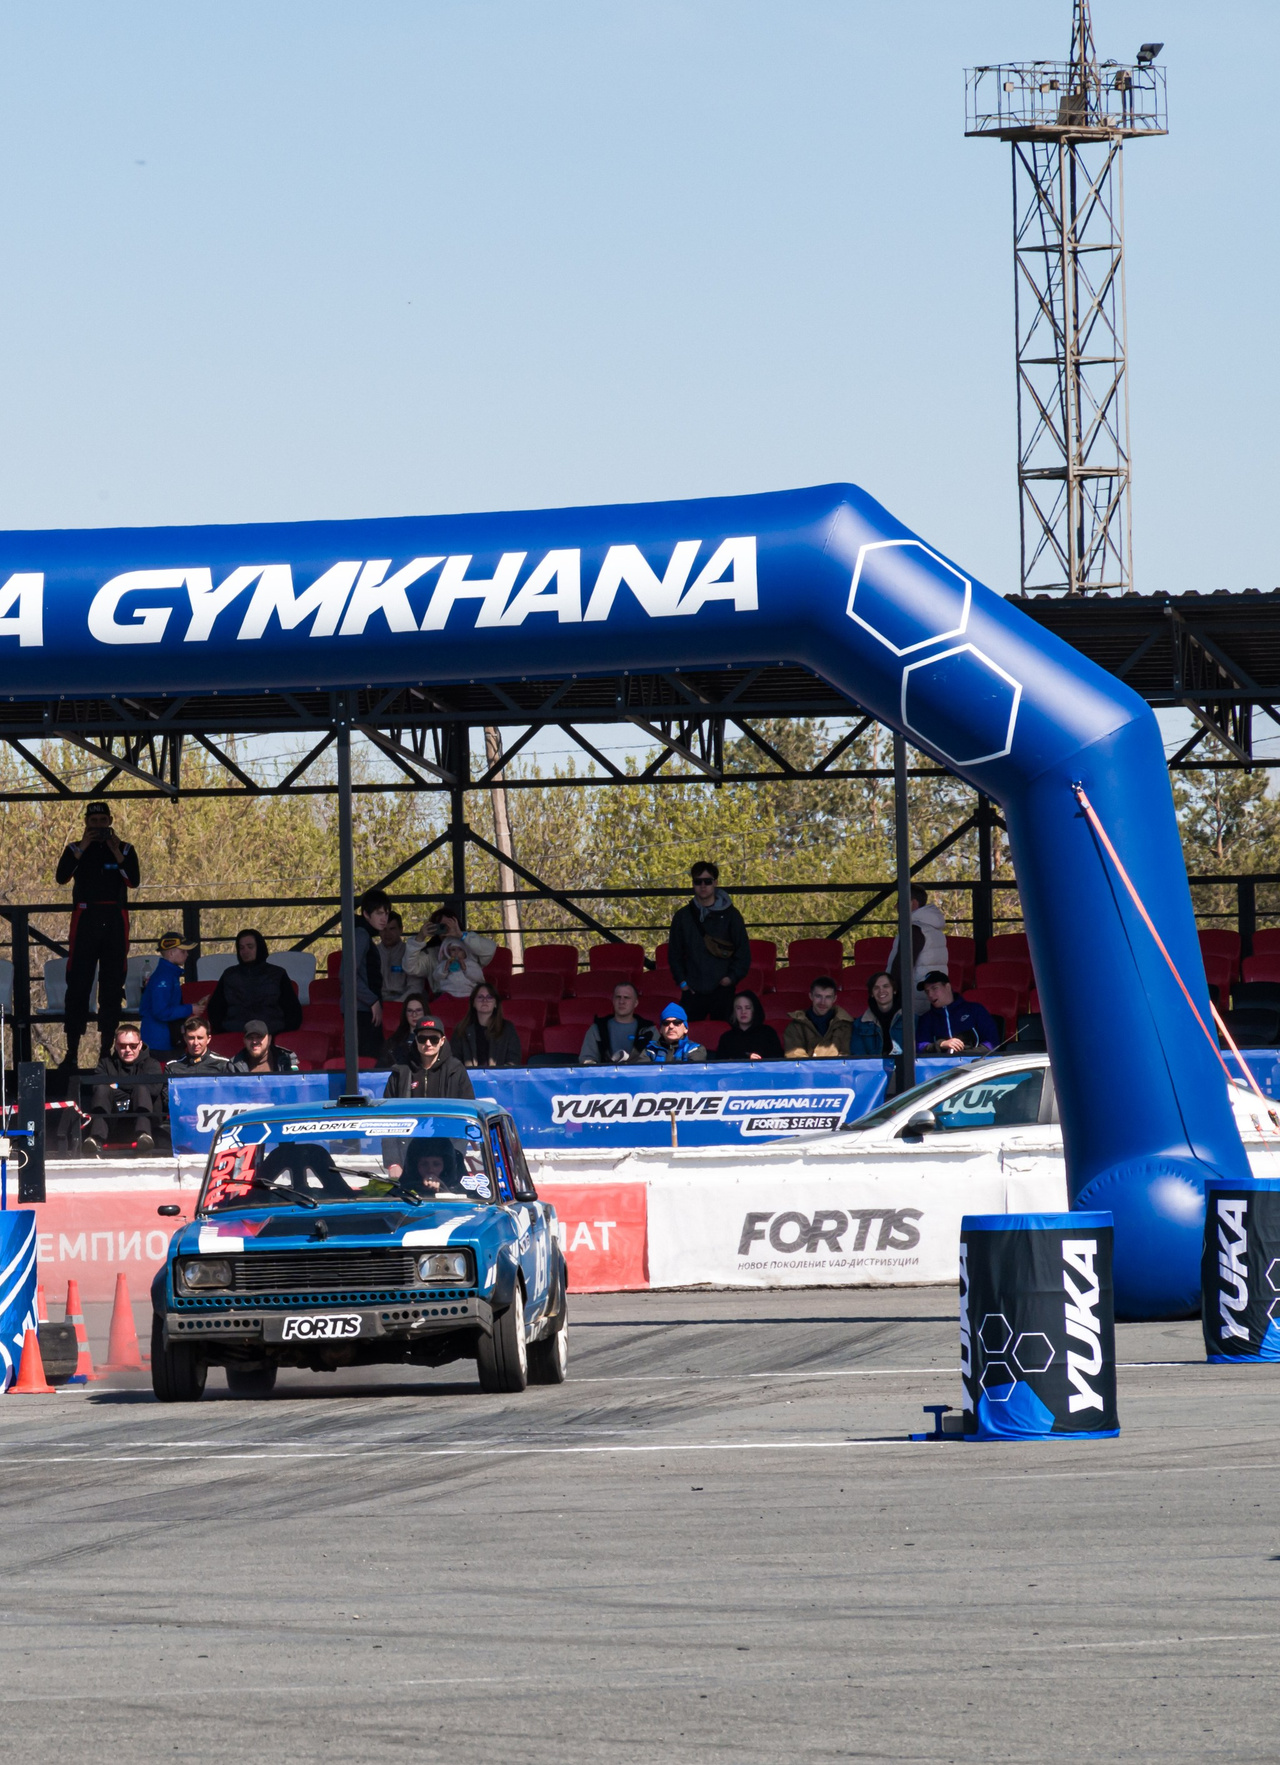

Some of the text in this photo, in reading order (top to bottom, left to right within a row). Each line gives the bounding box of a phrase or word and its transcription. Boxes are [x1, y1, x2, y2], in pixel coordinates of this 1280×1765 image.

[87, 536, 760, 645] GYMKHANA
[556, 1098, 628, 1118] YUKA
[633, 1096, 724, 1117] DRIVE
[949, 1089, 1006, 1109] YUK
[285, 1124, 317, 1132] YUKA
[320, 1122, 359, 1131] DRIVE
[751, 1116, 834, 1130] FORTIS SERIES
[211, 1144, 257, 1177] 51
[737, 1207, 925, 1256] FORTIS
[36, 1230, 170, 1263] ЕМПИО
[738, 1261, 768, 1271] НОВОЕ
[770, 1260, 827, 1269] ПОКОЛЕНИЕ
[1217, 1199, 1250, 1341] YUKA
[284, 1316, 359, 1338] FORTIS
[1062, 1239, 1104, 1414] YUKA
